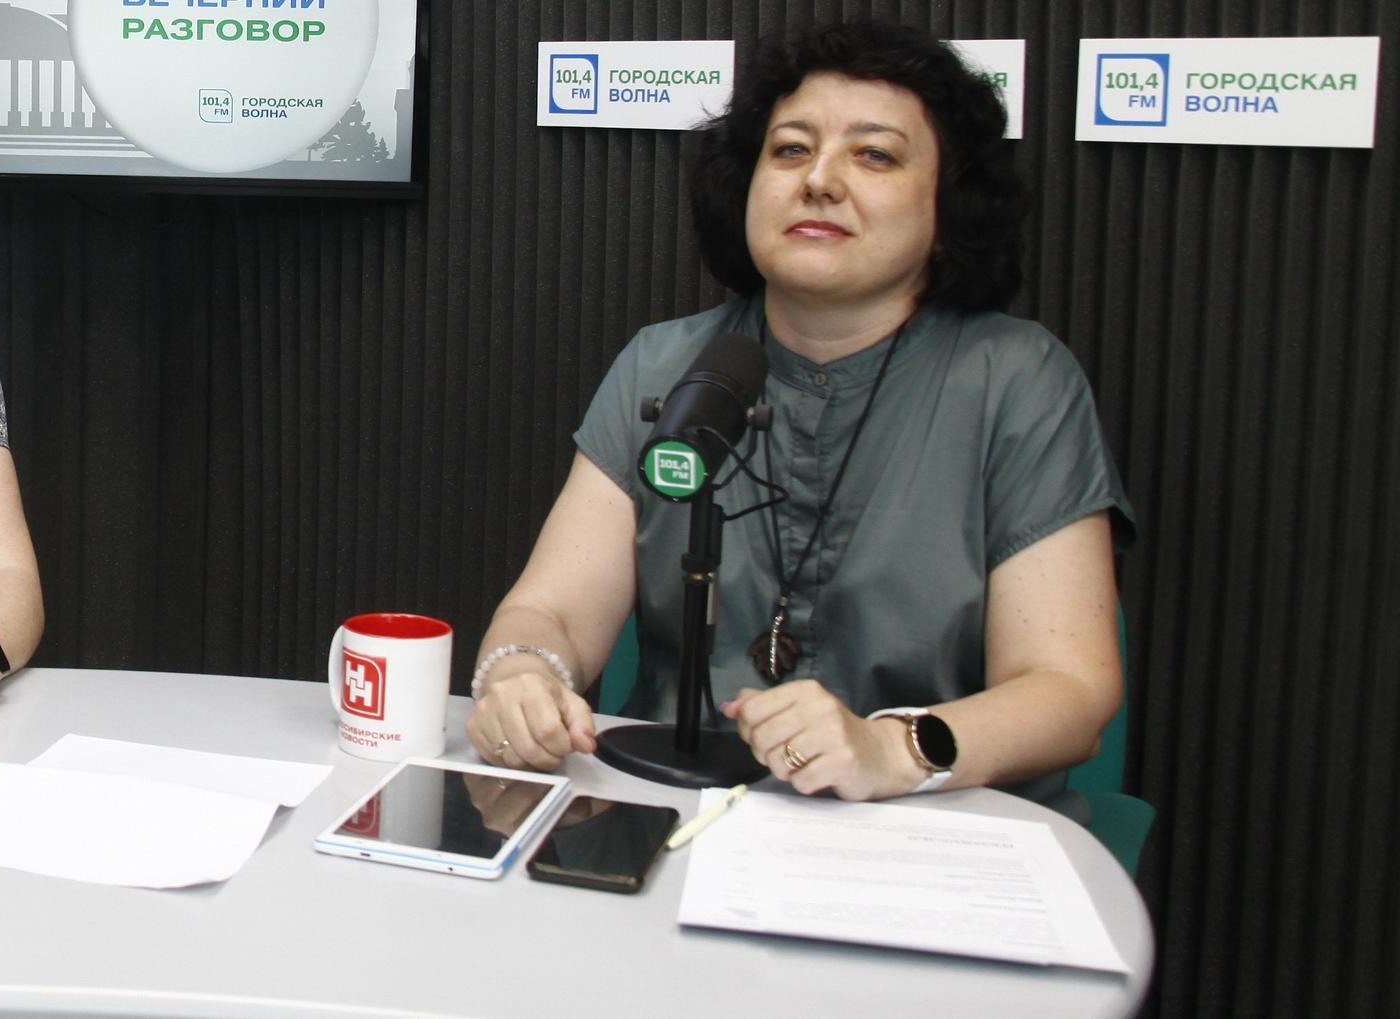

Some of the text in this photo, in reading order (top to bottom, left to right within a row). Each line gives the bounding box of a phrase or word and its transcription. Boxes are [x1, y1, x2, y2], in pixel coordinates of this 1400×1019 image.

[123, 18, 326, 42] РАЗГОВОР
[556, 70, 592, 86] 101,4
[609, 70, 720, 86] ГОРОДСКАЯ
[1105, 72, 1159, 91] 101,4
[1186, 73, 1357, 92] ГОРОДСКАЯ
[571, 88, 590, 99] FM
[609, 88, 671, 103] ВОЛНА
[202, 97, 230, 107] 101,4
[242, 97, 323, 108] ГОРОДСКАЯ
[1128, 95, 1156, 108] FM
[1184, 95, 1279, 113] ВОЛНА
[214, 108, 229, 116] FM
[241, 108, 288, 118] ВОЛНА
[672, 470, 689, 479] FM
